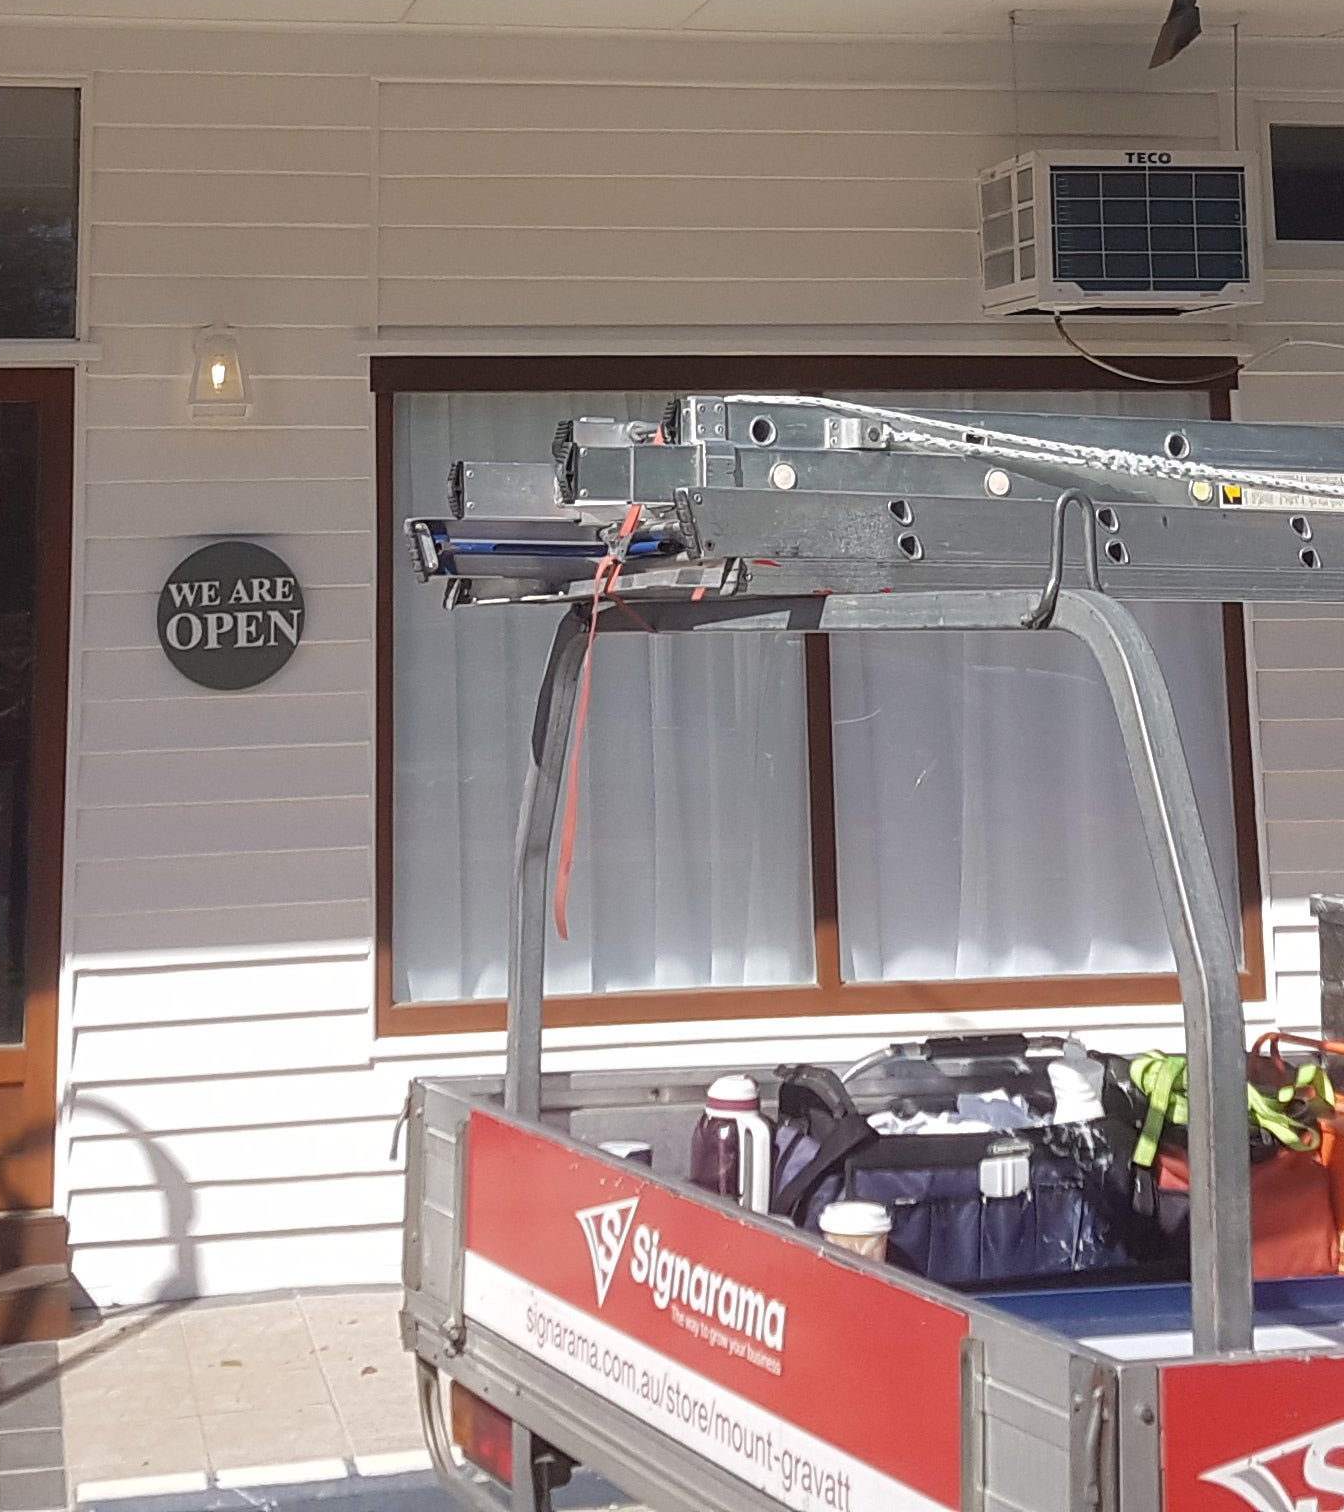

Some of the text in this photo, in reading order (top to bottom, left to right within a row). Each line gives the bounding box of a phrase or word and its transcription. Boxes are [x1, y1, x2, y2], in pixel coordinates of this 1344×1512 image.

[1124, 152, 1172, 164] TECO
[167, 576, 296, 609] WE ARE
[165, 608, 303, 651] OPEN
[630, 1223, 787, 1352] Signarama
[671, 1304, 685, 1328] The
[685, 1316, 700, 1338] way
[525, 1302, 852, 1512] signarama.com.au/store/mount-gravatt
